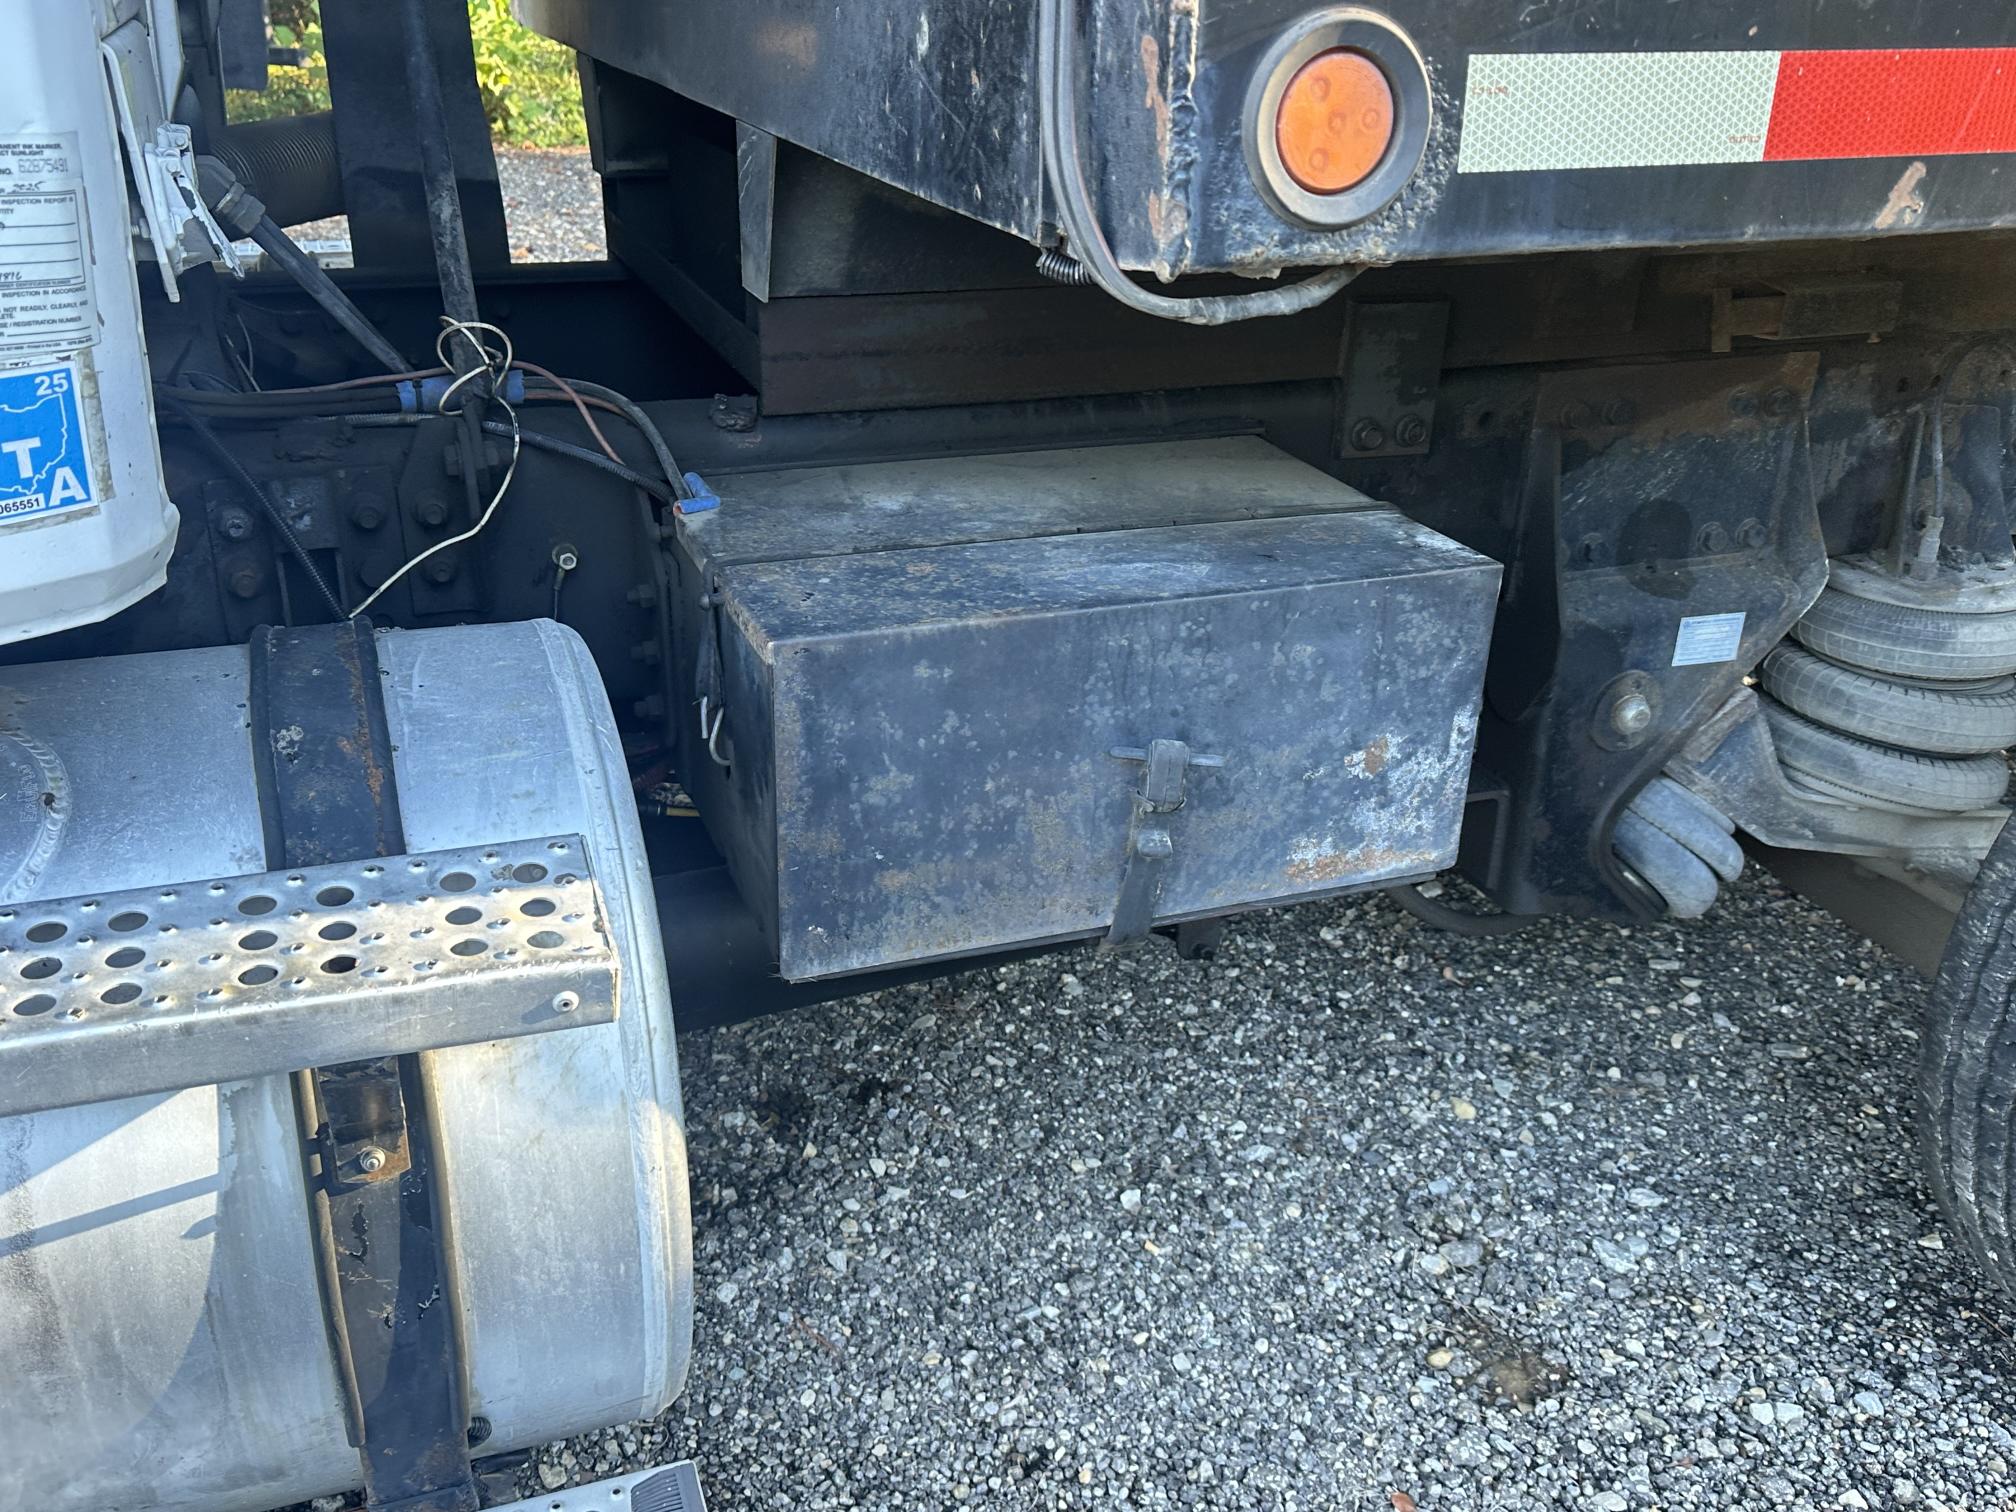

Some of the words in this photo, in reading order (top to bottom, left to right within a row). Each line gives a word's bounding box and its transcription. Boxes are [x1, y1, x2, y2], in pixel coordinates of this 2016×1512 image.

[44, 196, 67, 204] REPORT
[2, 289, 41, 298] INSPECTION
[51, 285, 86, 295] ACCORDANCE
[13, 319, 57, 327] REGISTRATION
[34, 372, 69, 396] 25
[1, 436, 41, 479] T
[48, 466, 88, 507] A
